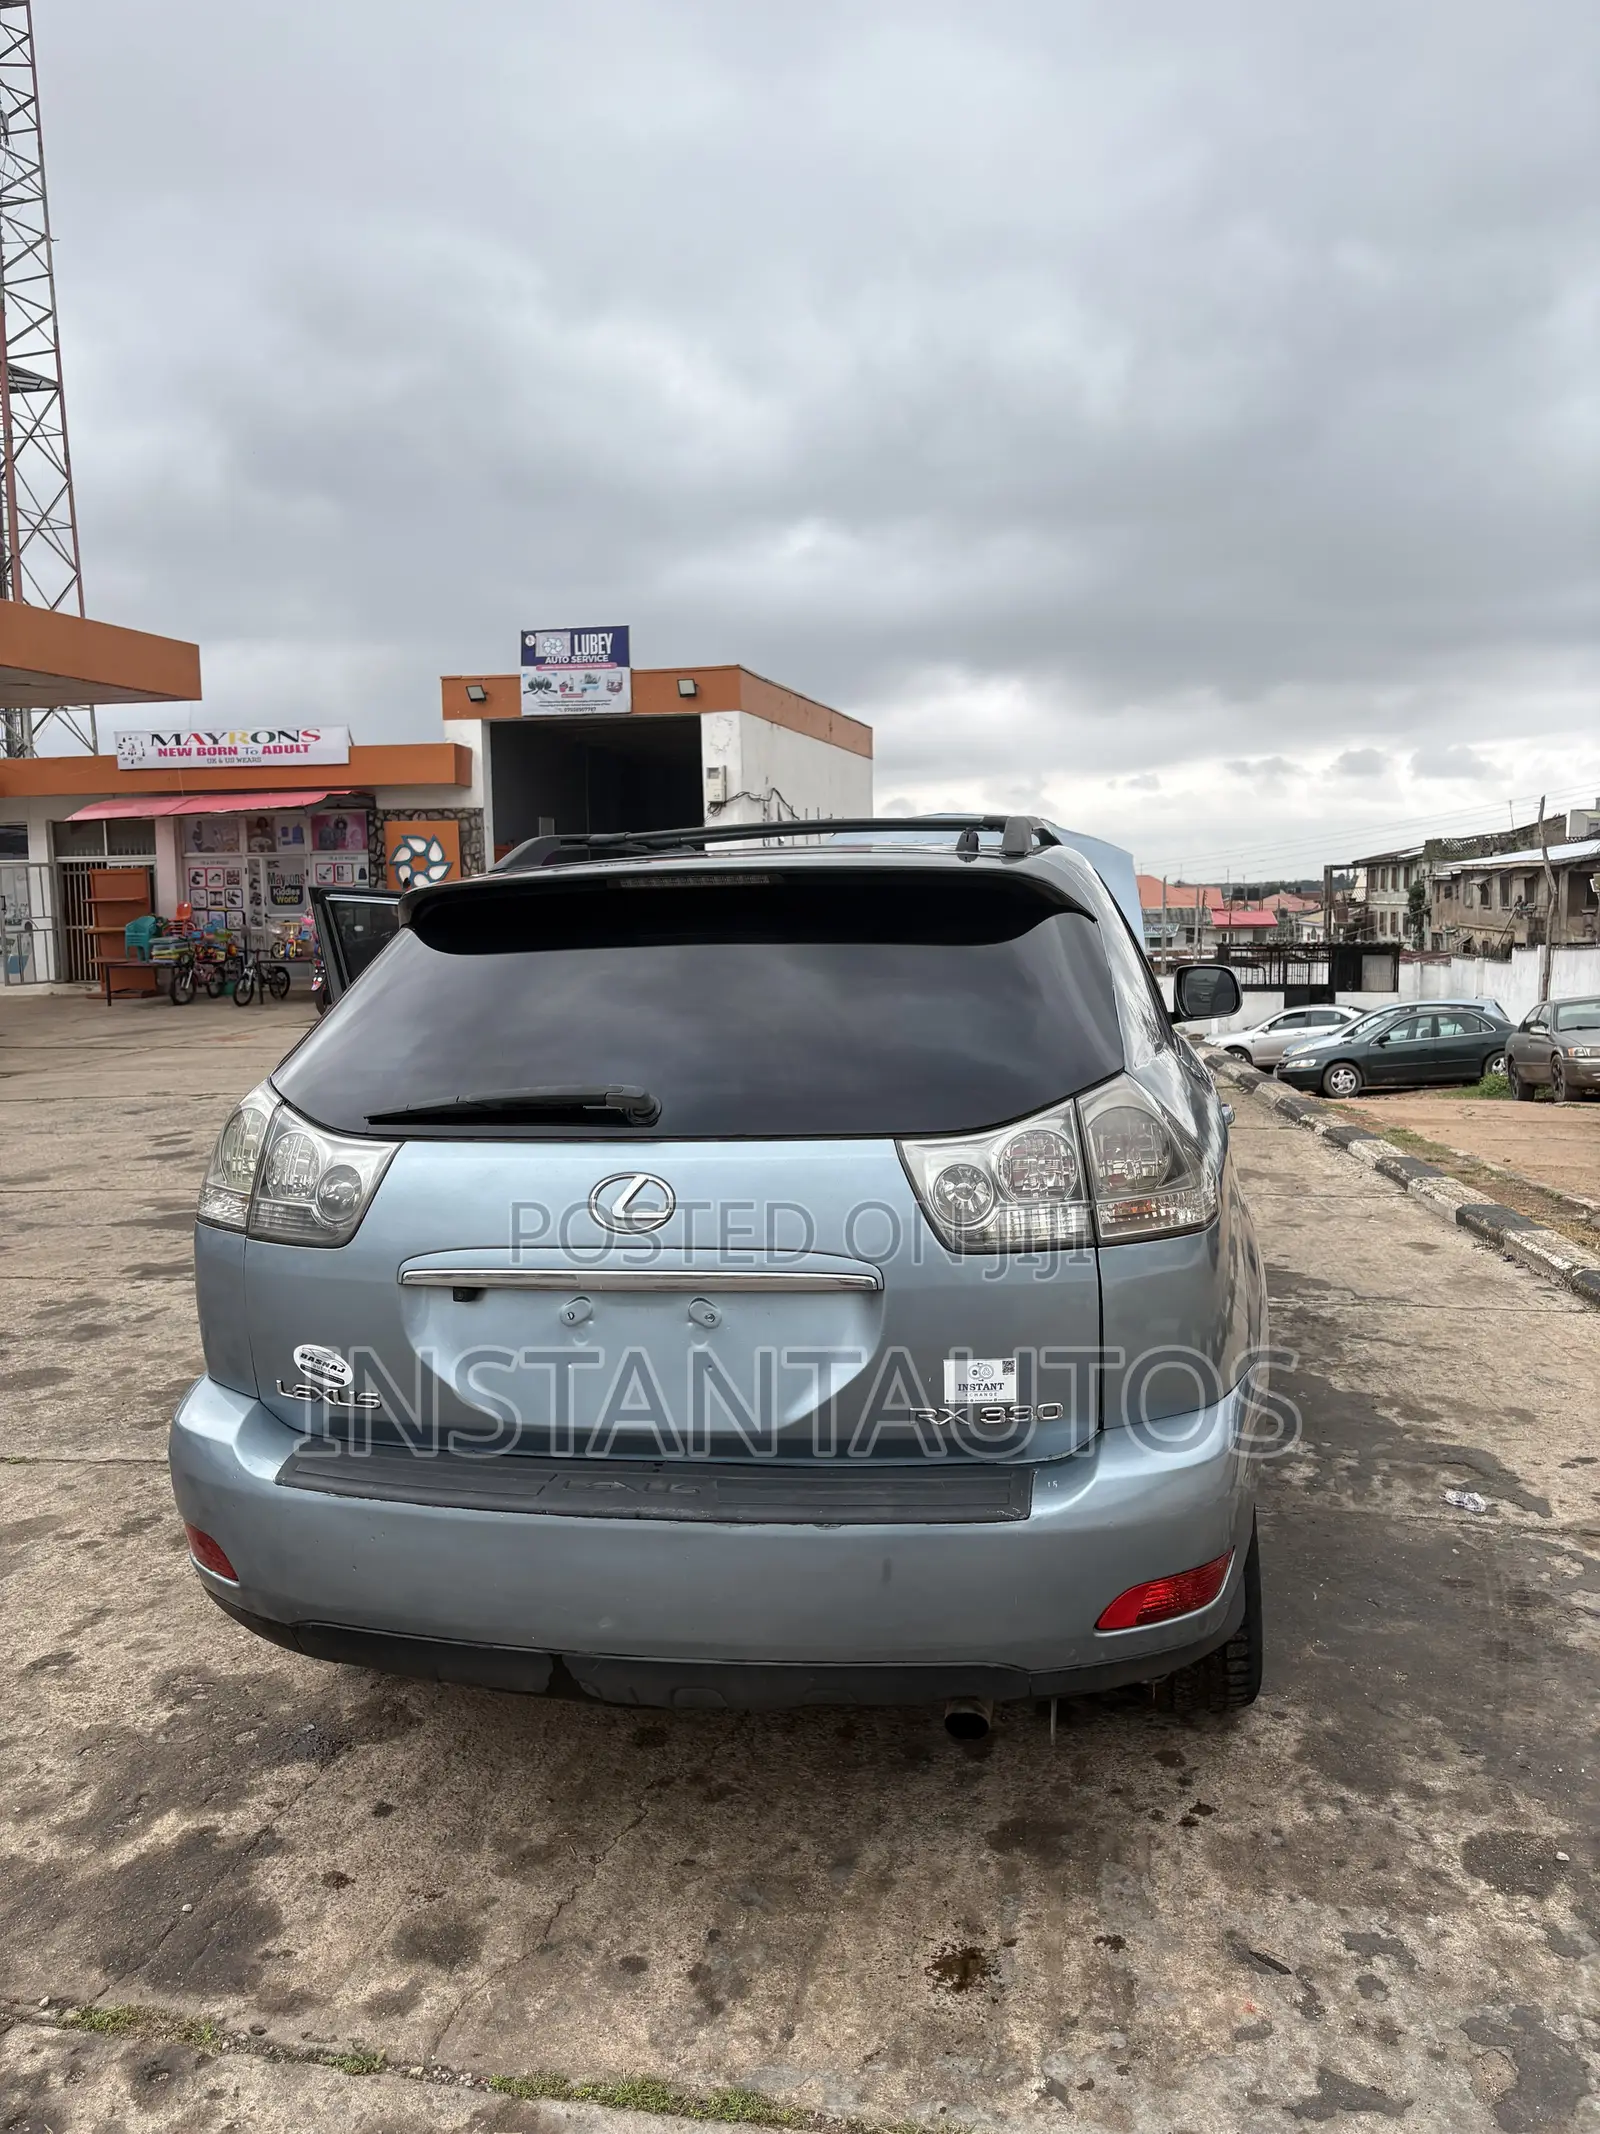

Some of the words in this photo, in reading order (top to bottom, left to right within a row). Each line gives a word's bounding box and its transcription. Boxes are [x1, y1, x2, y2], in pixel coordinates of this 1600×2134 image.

[574, 633, 613, 656] LUBEY
[545, 656, 569, 664] AUTO
[571, 655, 608, 663] SERVICE
[151, 728, 321, 747] MAYRONS
[157, 747, 192, 757] NEW
[197, 746, 238, 756] BORN
[241, 746, 258, 755] To
[262, 744, 310, 755] ADULT
[273, 887, 300, 896] Kiddies
[276, 895, 299, 903] World
[300, 1352, 346, 1374] BASNAJ
[275, 1379, 381, 1409] LEXUS
[958, 1382, 1004, 1392] INSTANT
[909, 1407, 970, 1425] RX
[980, 1402, 1064, 1424] 330
